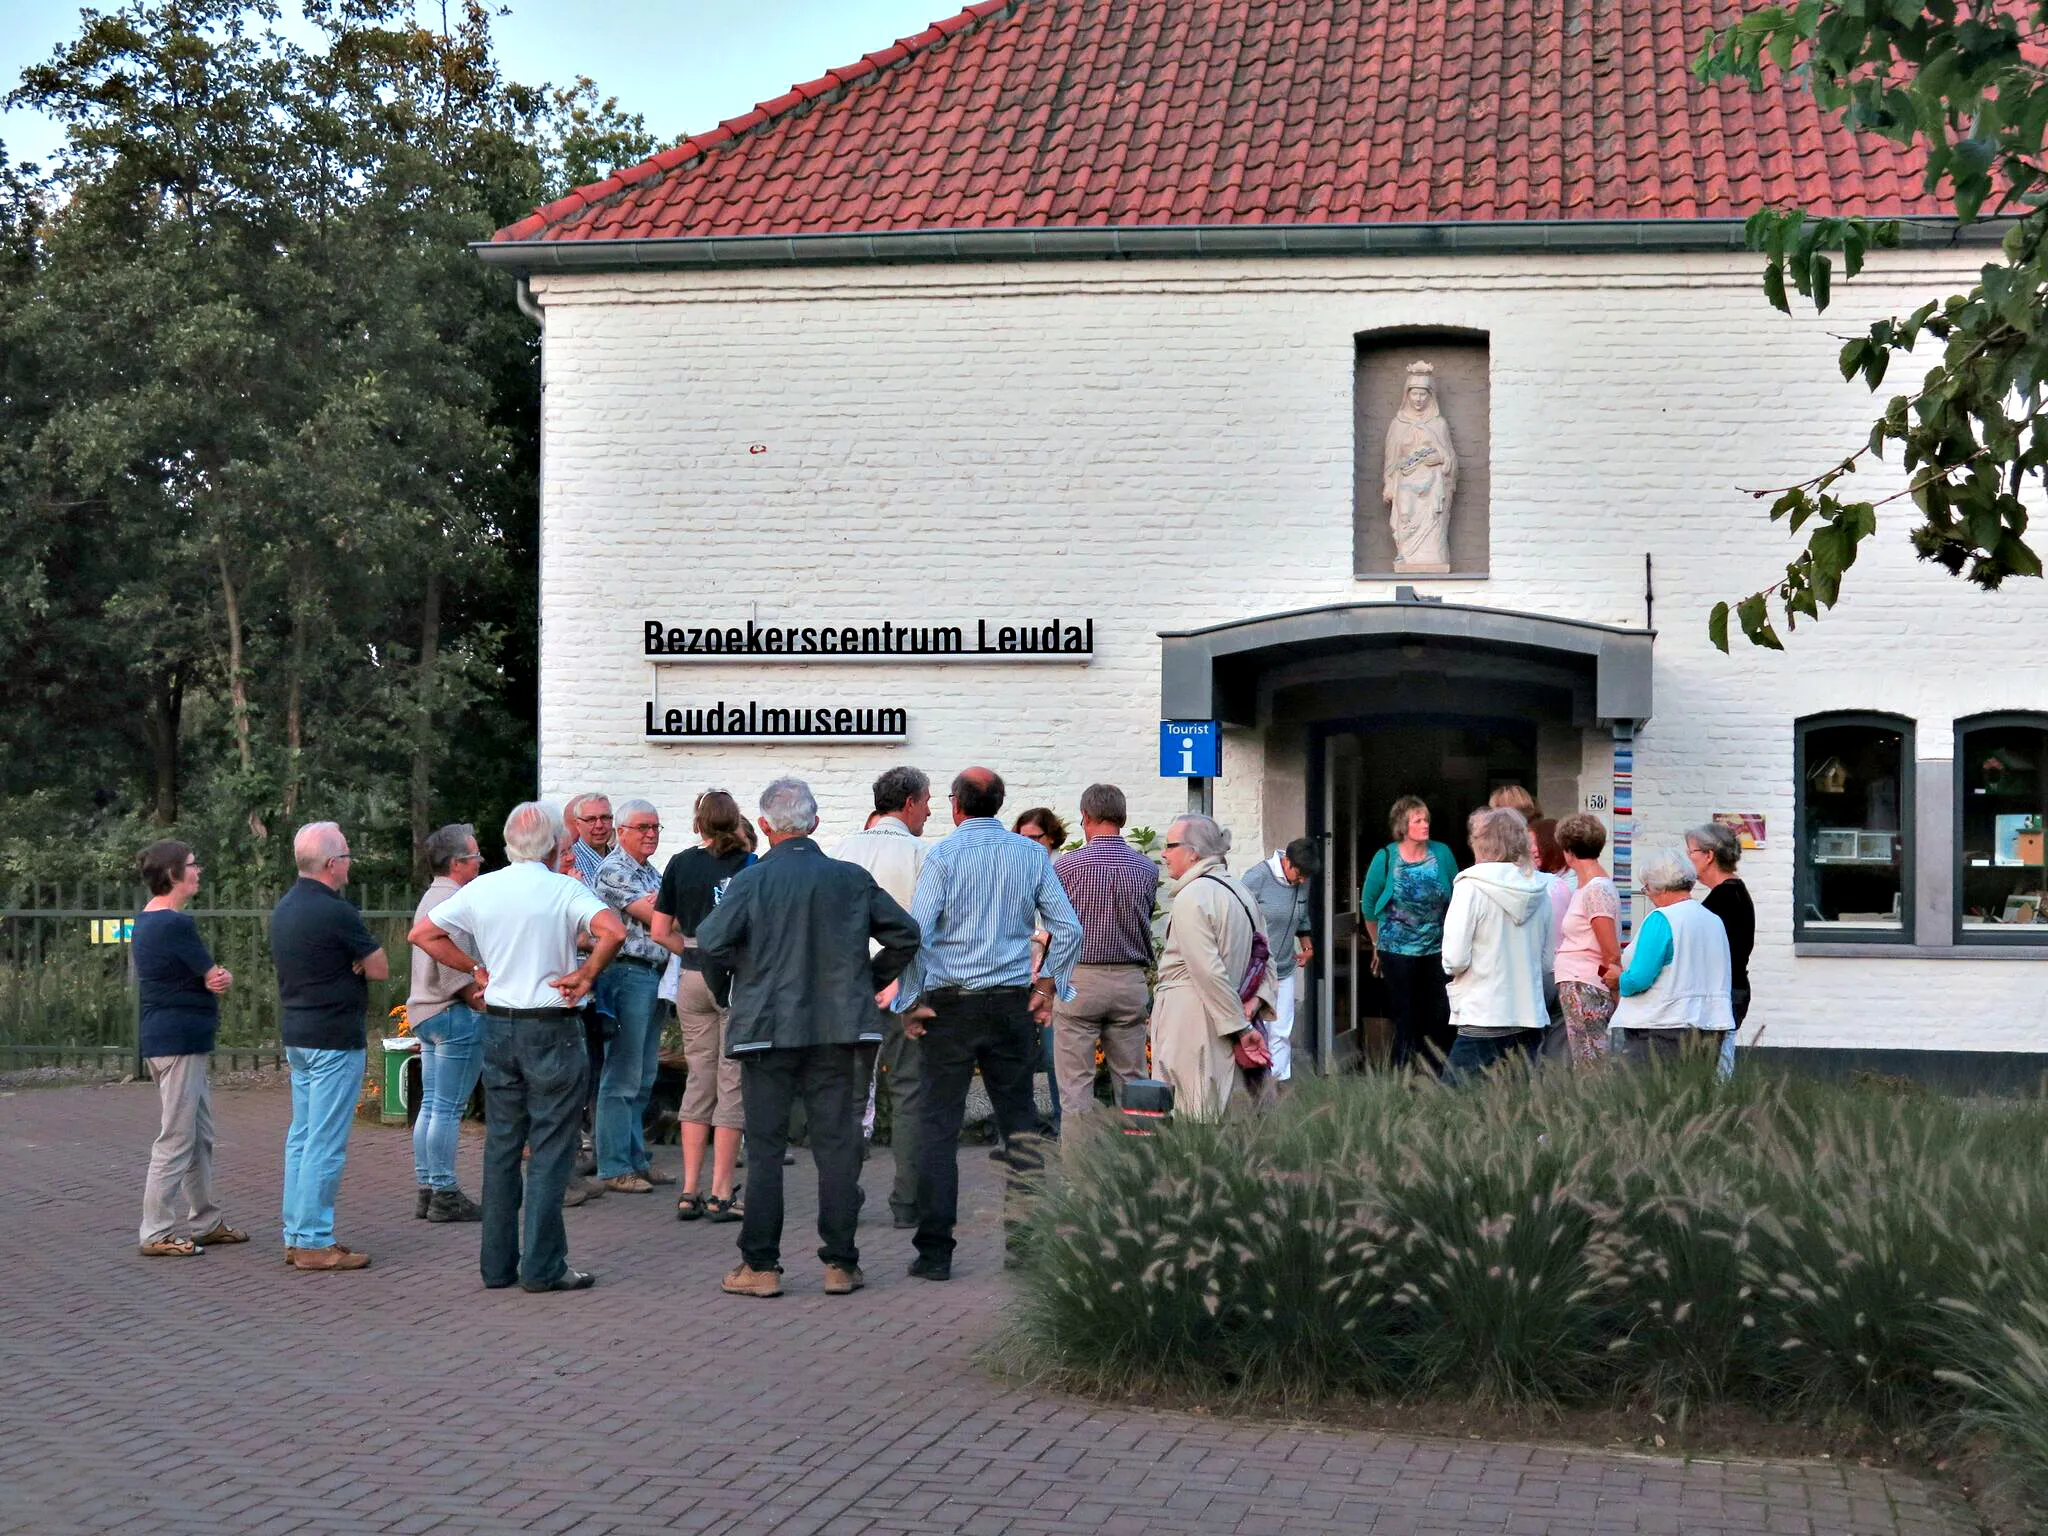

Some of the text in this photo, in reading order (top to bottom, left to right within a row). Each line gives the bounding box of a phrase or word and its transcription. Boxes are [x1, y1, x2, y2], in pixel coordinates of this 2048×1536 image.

[644, 618, 1094, 655] Bezoekerscentrum Leudal
[645, 701, 907, 735] Leudalmuseum
[1167, 723, 1209, 735] Tourist
[1178, 737, 1198, 774] i
[1590, 794, 1604, 809] 58
